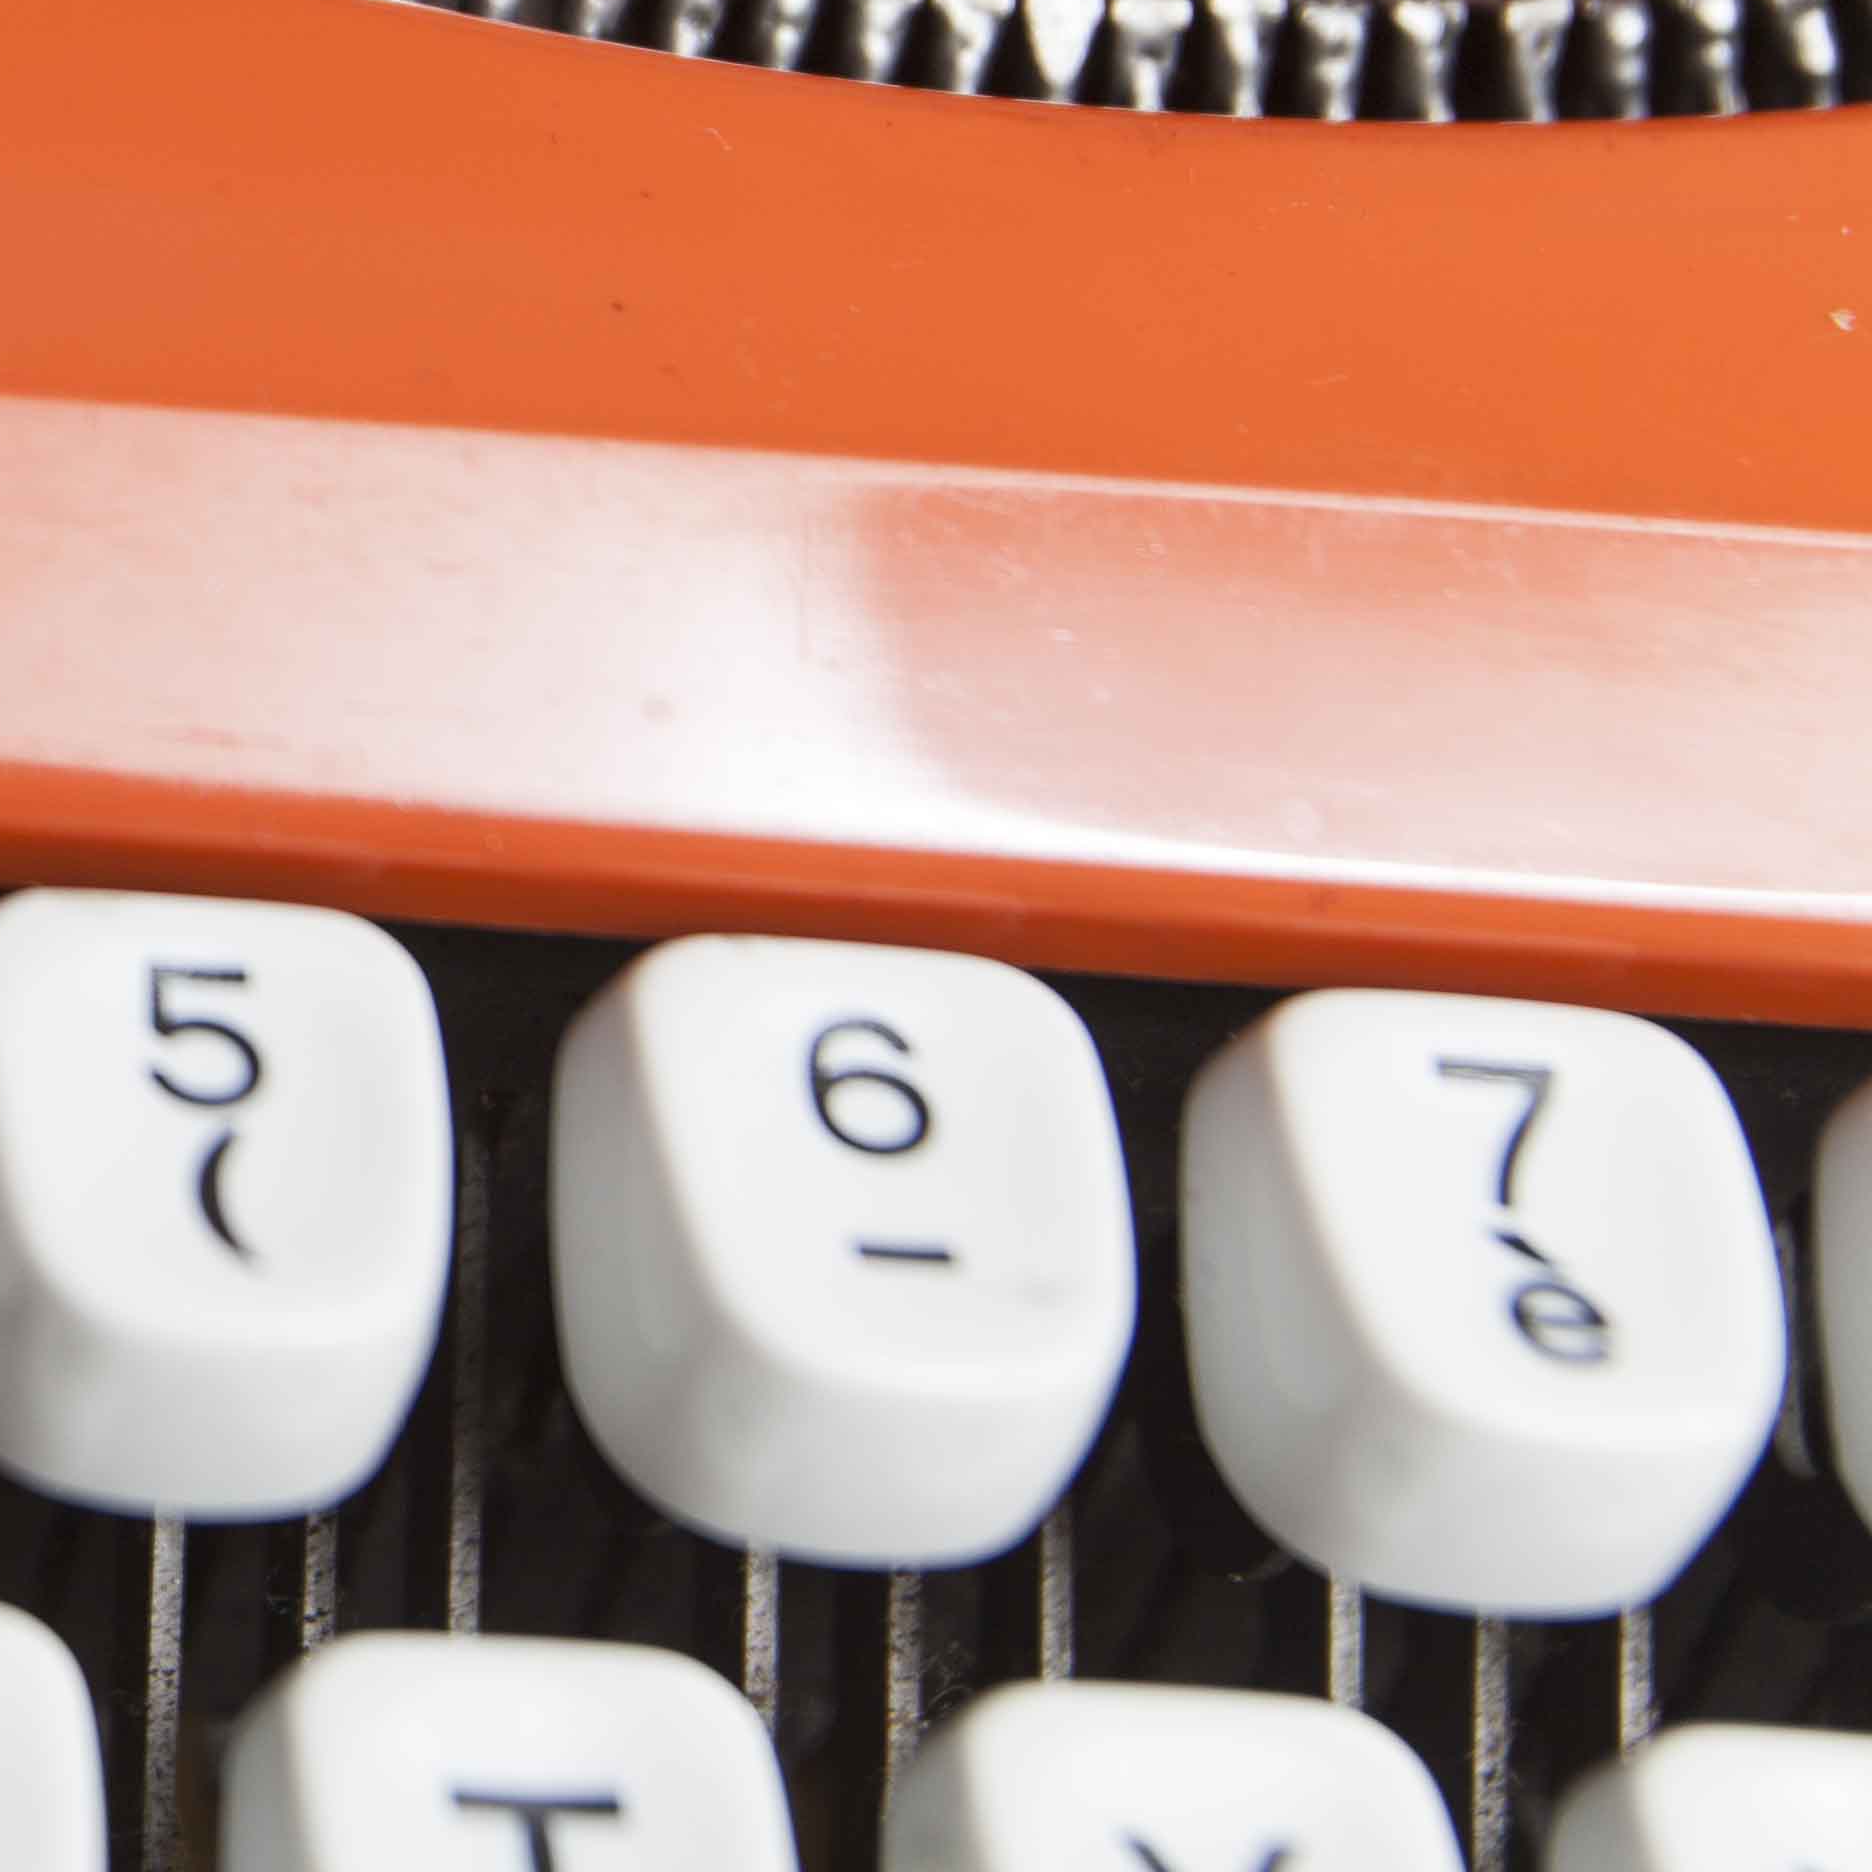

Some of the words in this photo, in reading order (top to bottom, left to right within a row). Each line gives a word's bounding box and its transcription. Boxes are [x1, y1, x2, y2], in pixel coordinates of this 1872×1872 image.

[148, 966, 264, 1109] 5
[806, 1018, 934, 1159] 6
[1436, 1060, 1553, 1209] 7
